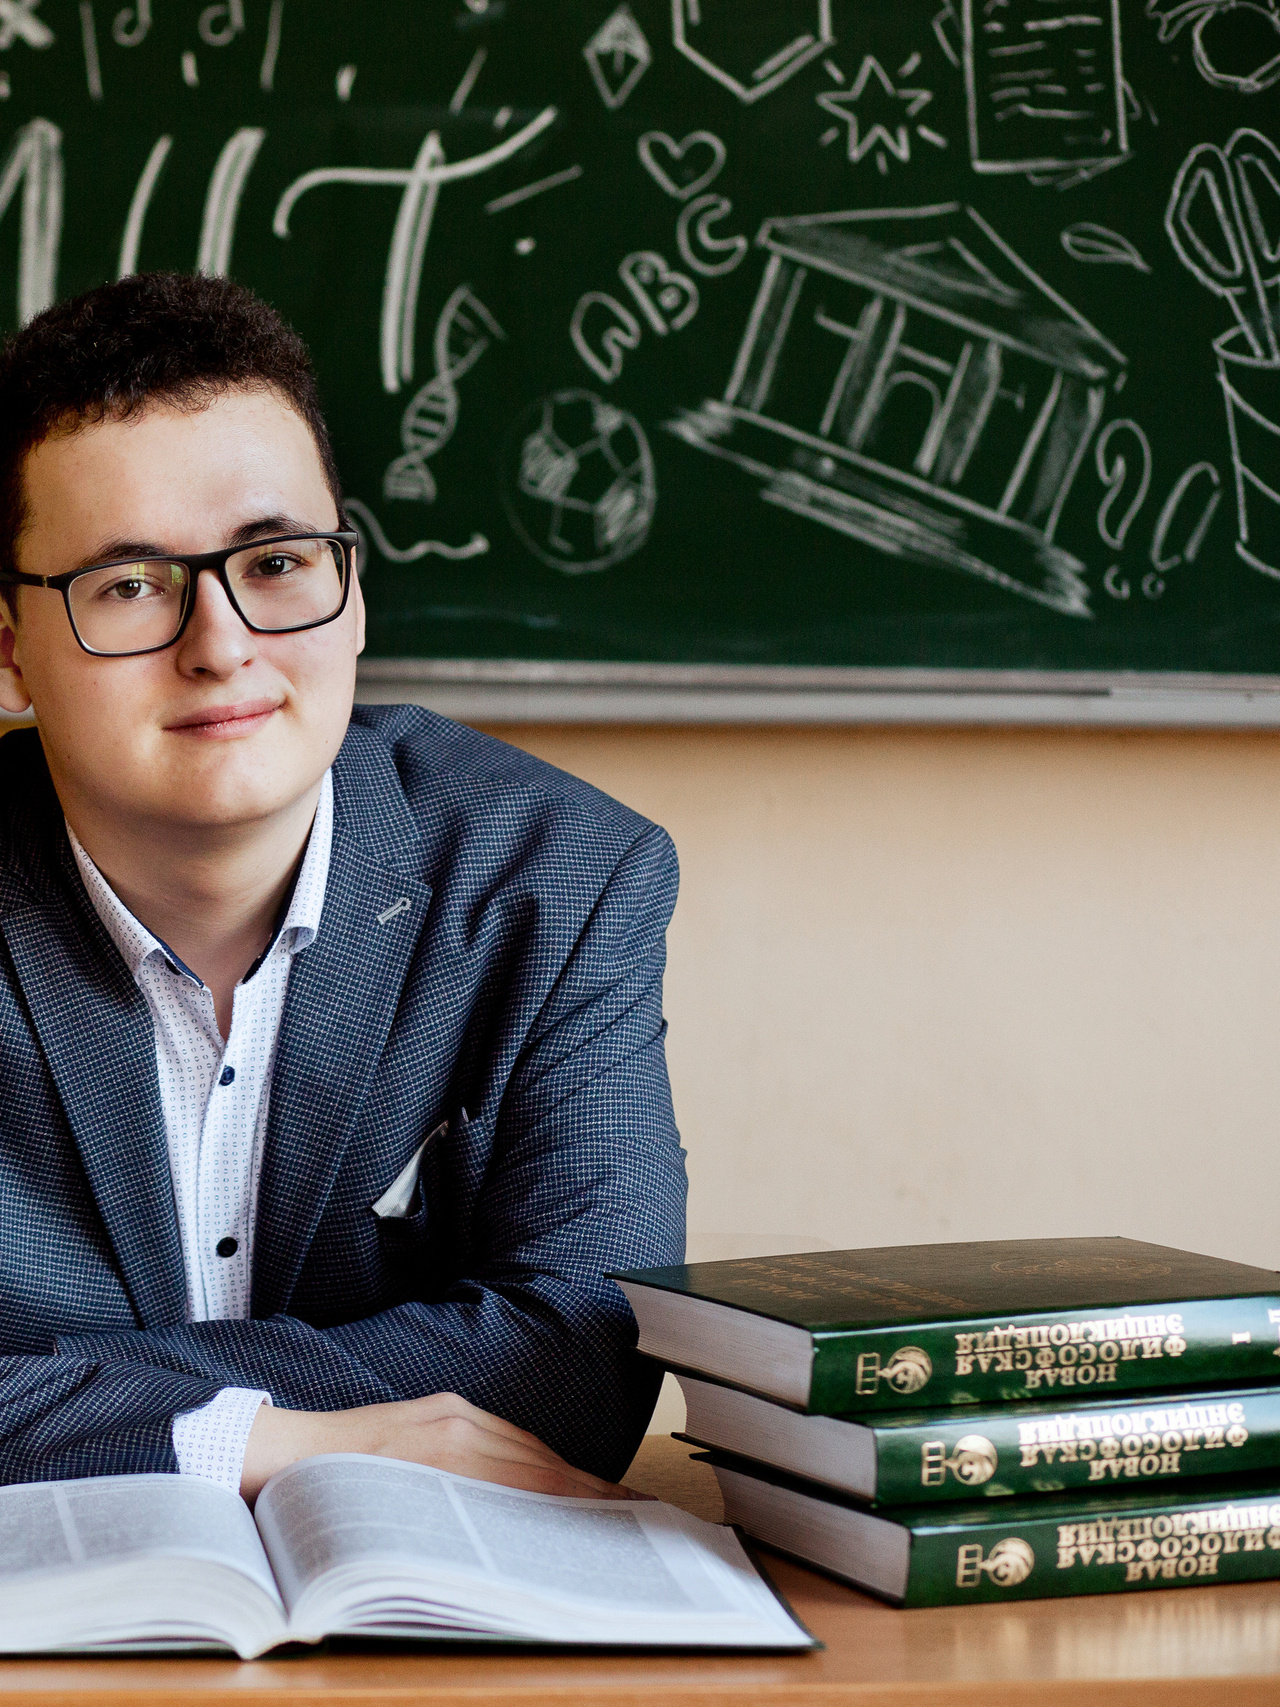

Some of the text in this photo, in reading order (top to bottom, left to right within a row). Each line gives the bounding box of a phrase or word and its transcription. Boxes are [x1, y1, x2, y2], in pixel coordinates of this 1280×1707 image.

[954, 1313, 1184, 1355] ЭНЦИКЛОПЕДИЯ
[955, 1335, 1187, 1375] ФИЛОСОФСКАЯ
[1025, 1362, 1117, 1389] НОВАЯ
[1017, 1402, 1245, 1444] ЭНЦИКЛОПЕДИЯ
[1019, 1424, 1249, 1467] ФИЛОСОФСКАЯ
[1088, 1453, 1181, 1481] НОВАЯ
[1125, 1554, 1220, 1582] НОВАЯ
